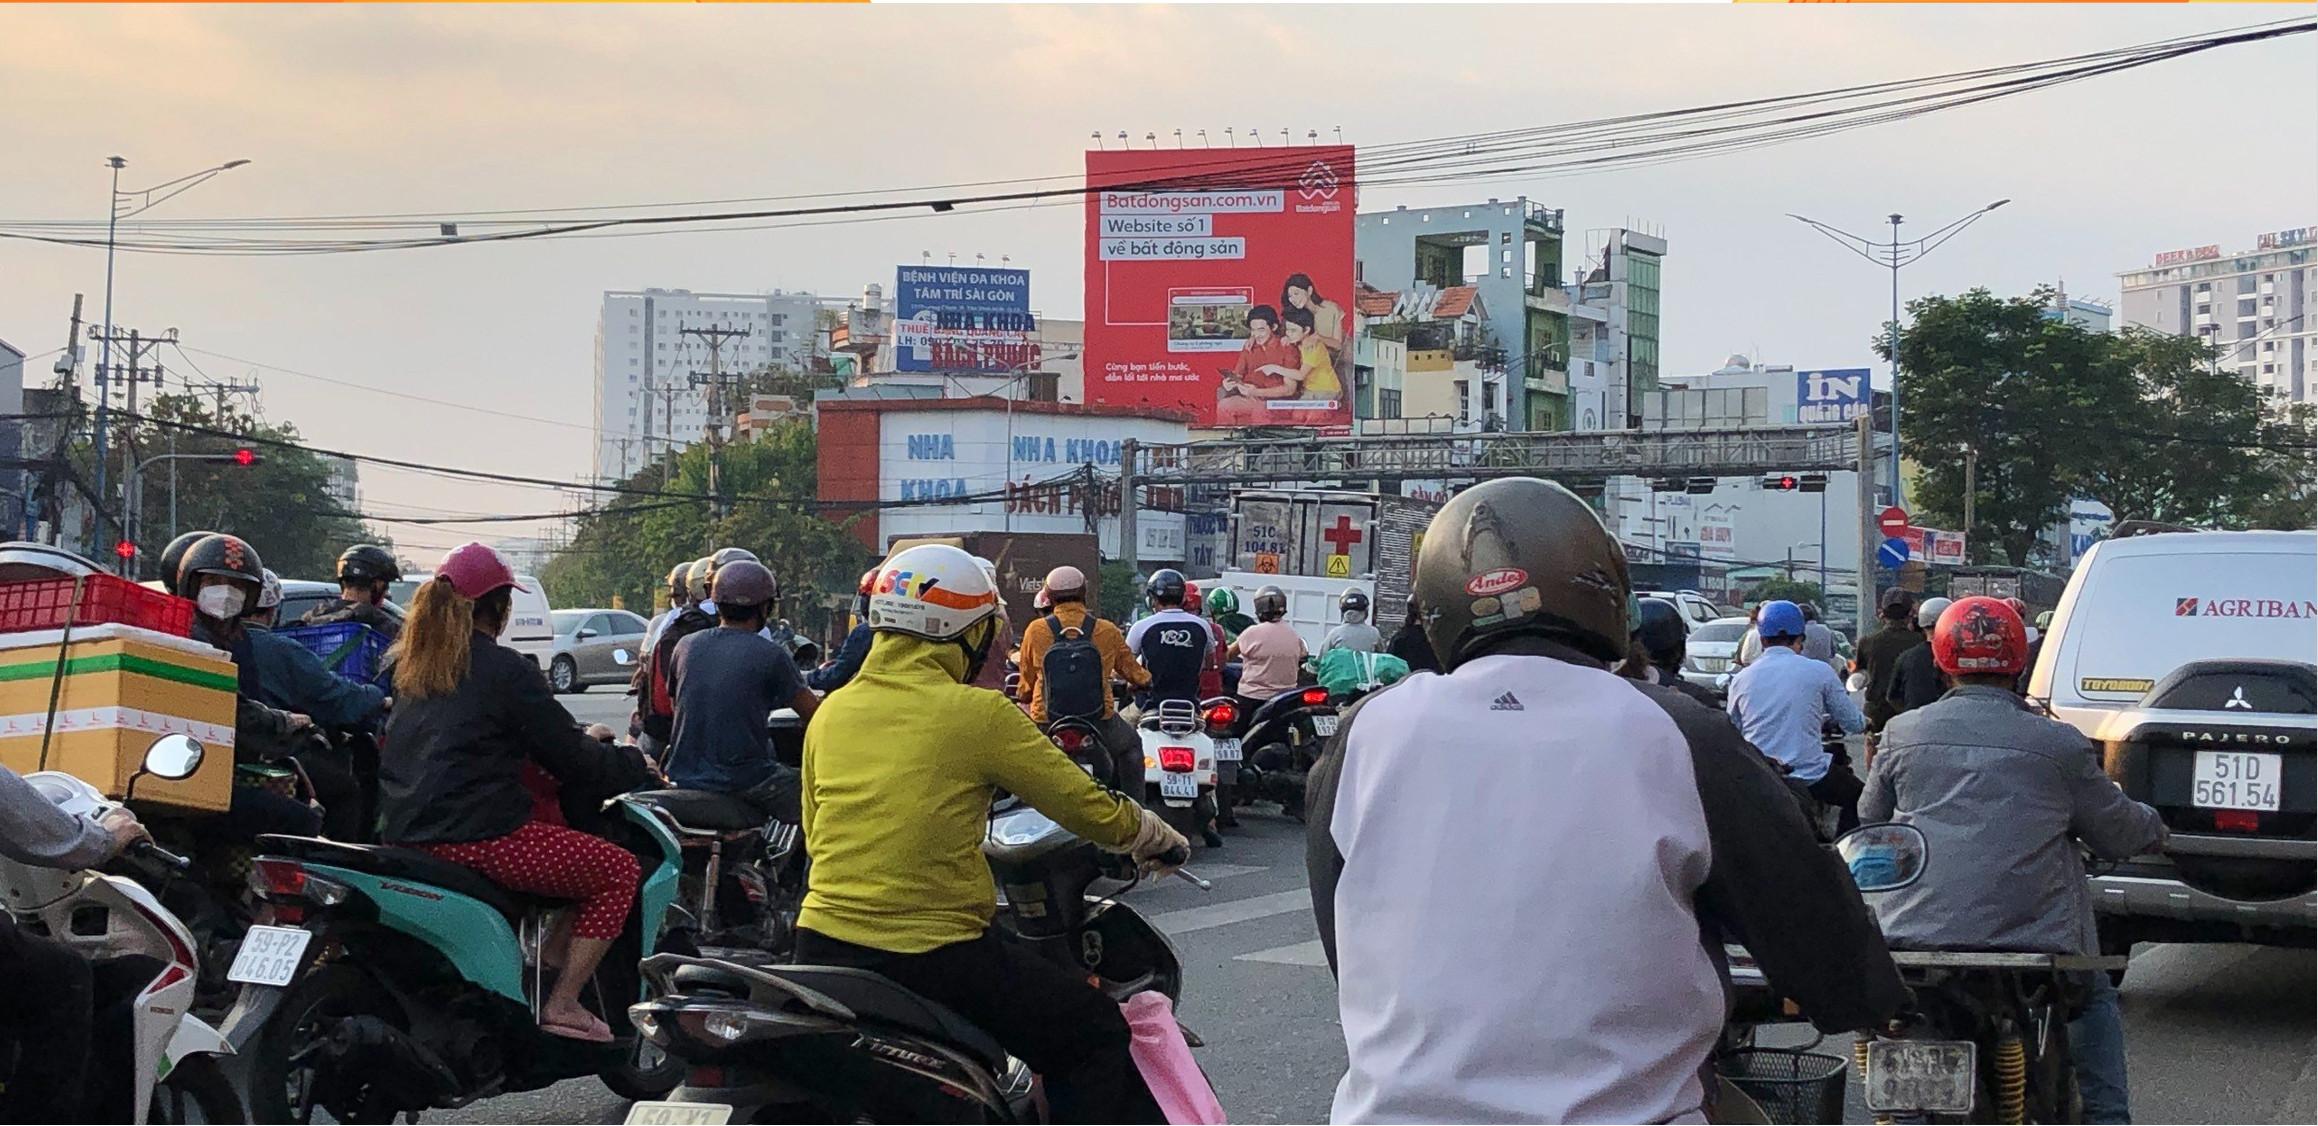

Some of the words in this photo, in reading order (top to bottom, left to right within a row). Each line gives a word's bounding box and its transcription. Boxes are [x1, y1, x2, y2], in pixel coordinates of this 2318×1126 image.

[1107, 193, 1277, 212] Batdongsan.com.vn
[1108, 219, 1172, 232] Website
[1177, 216, 1196, 232] số
[1199, 219, 1204, 232] 1
[1108, 240, 1127, 255] về
[1131, 240, 1158, 255] bất
[1163, 240, 1205, 258] động
[1209, 240, 1239, 255] sản
[903, 270, 936, 284] BỆNH
[939, 271, 967, 286] VIỆN
[969, 273, 987, 284] ĐA
[990, 274, 1025, 286] KHOA
[914, 286, 941, 299] TÂM
[943, 287, 963, 300] TRÍ
[965, 287, 985, 300] SÀI
[987, 289, 1015, 301] GÒN
[907, 434, 955, 460] NHA
[1013, 436, 1056, 463] NHA
[1066, 438, 1122, 465] KHOA
[901, 478, 967, 501] KHOA
[1253, 526, 1276, 538] 51C
[2182, 731, 2290, 744] PAJERO
[2215, 754, 2260, 780] 51D
[1167, 774, 1191, 785] 59-T1
[2196, 780, 2275, 808] 561.54
[252, 931, 300, 956] 59-P2
[234, 956, 295, 981] 046.05
